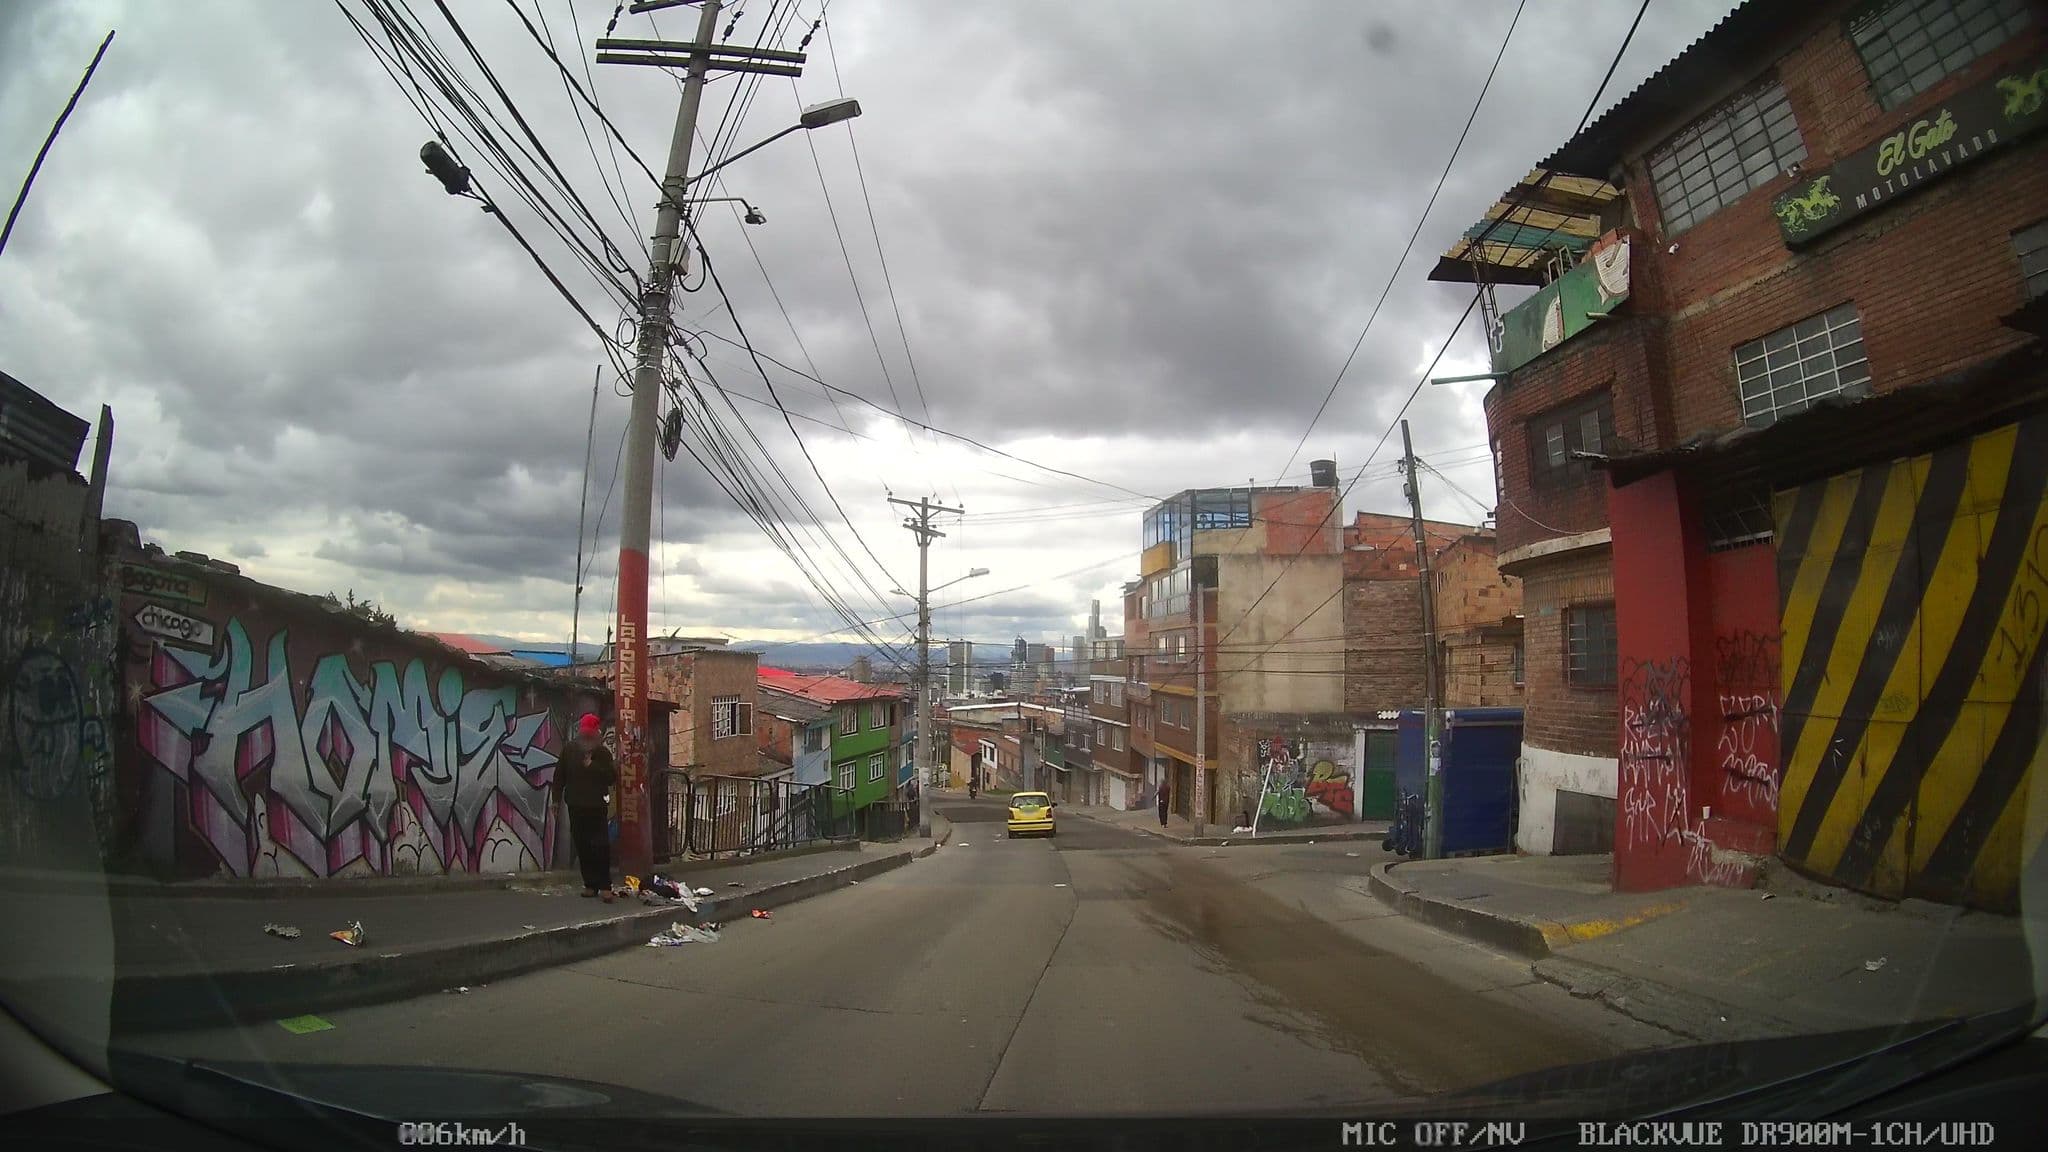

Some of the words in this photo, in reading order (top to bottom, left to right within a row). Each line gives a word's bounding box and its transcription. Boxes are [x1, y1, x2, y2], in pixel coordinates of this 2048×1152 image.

[1855, 128, 1998, 210] MOTOLAVADO
[1876, 131, 1906, 176] El
[1907, 108, 1959, 160] Gato
[619, 613, 636, 722] LATONERIA
